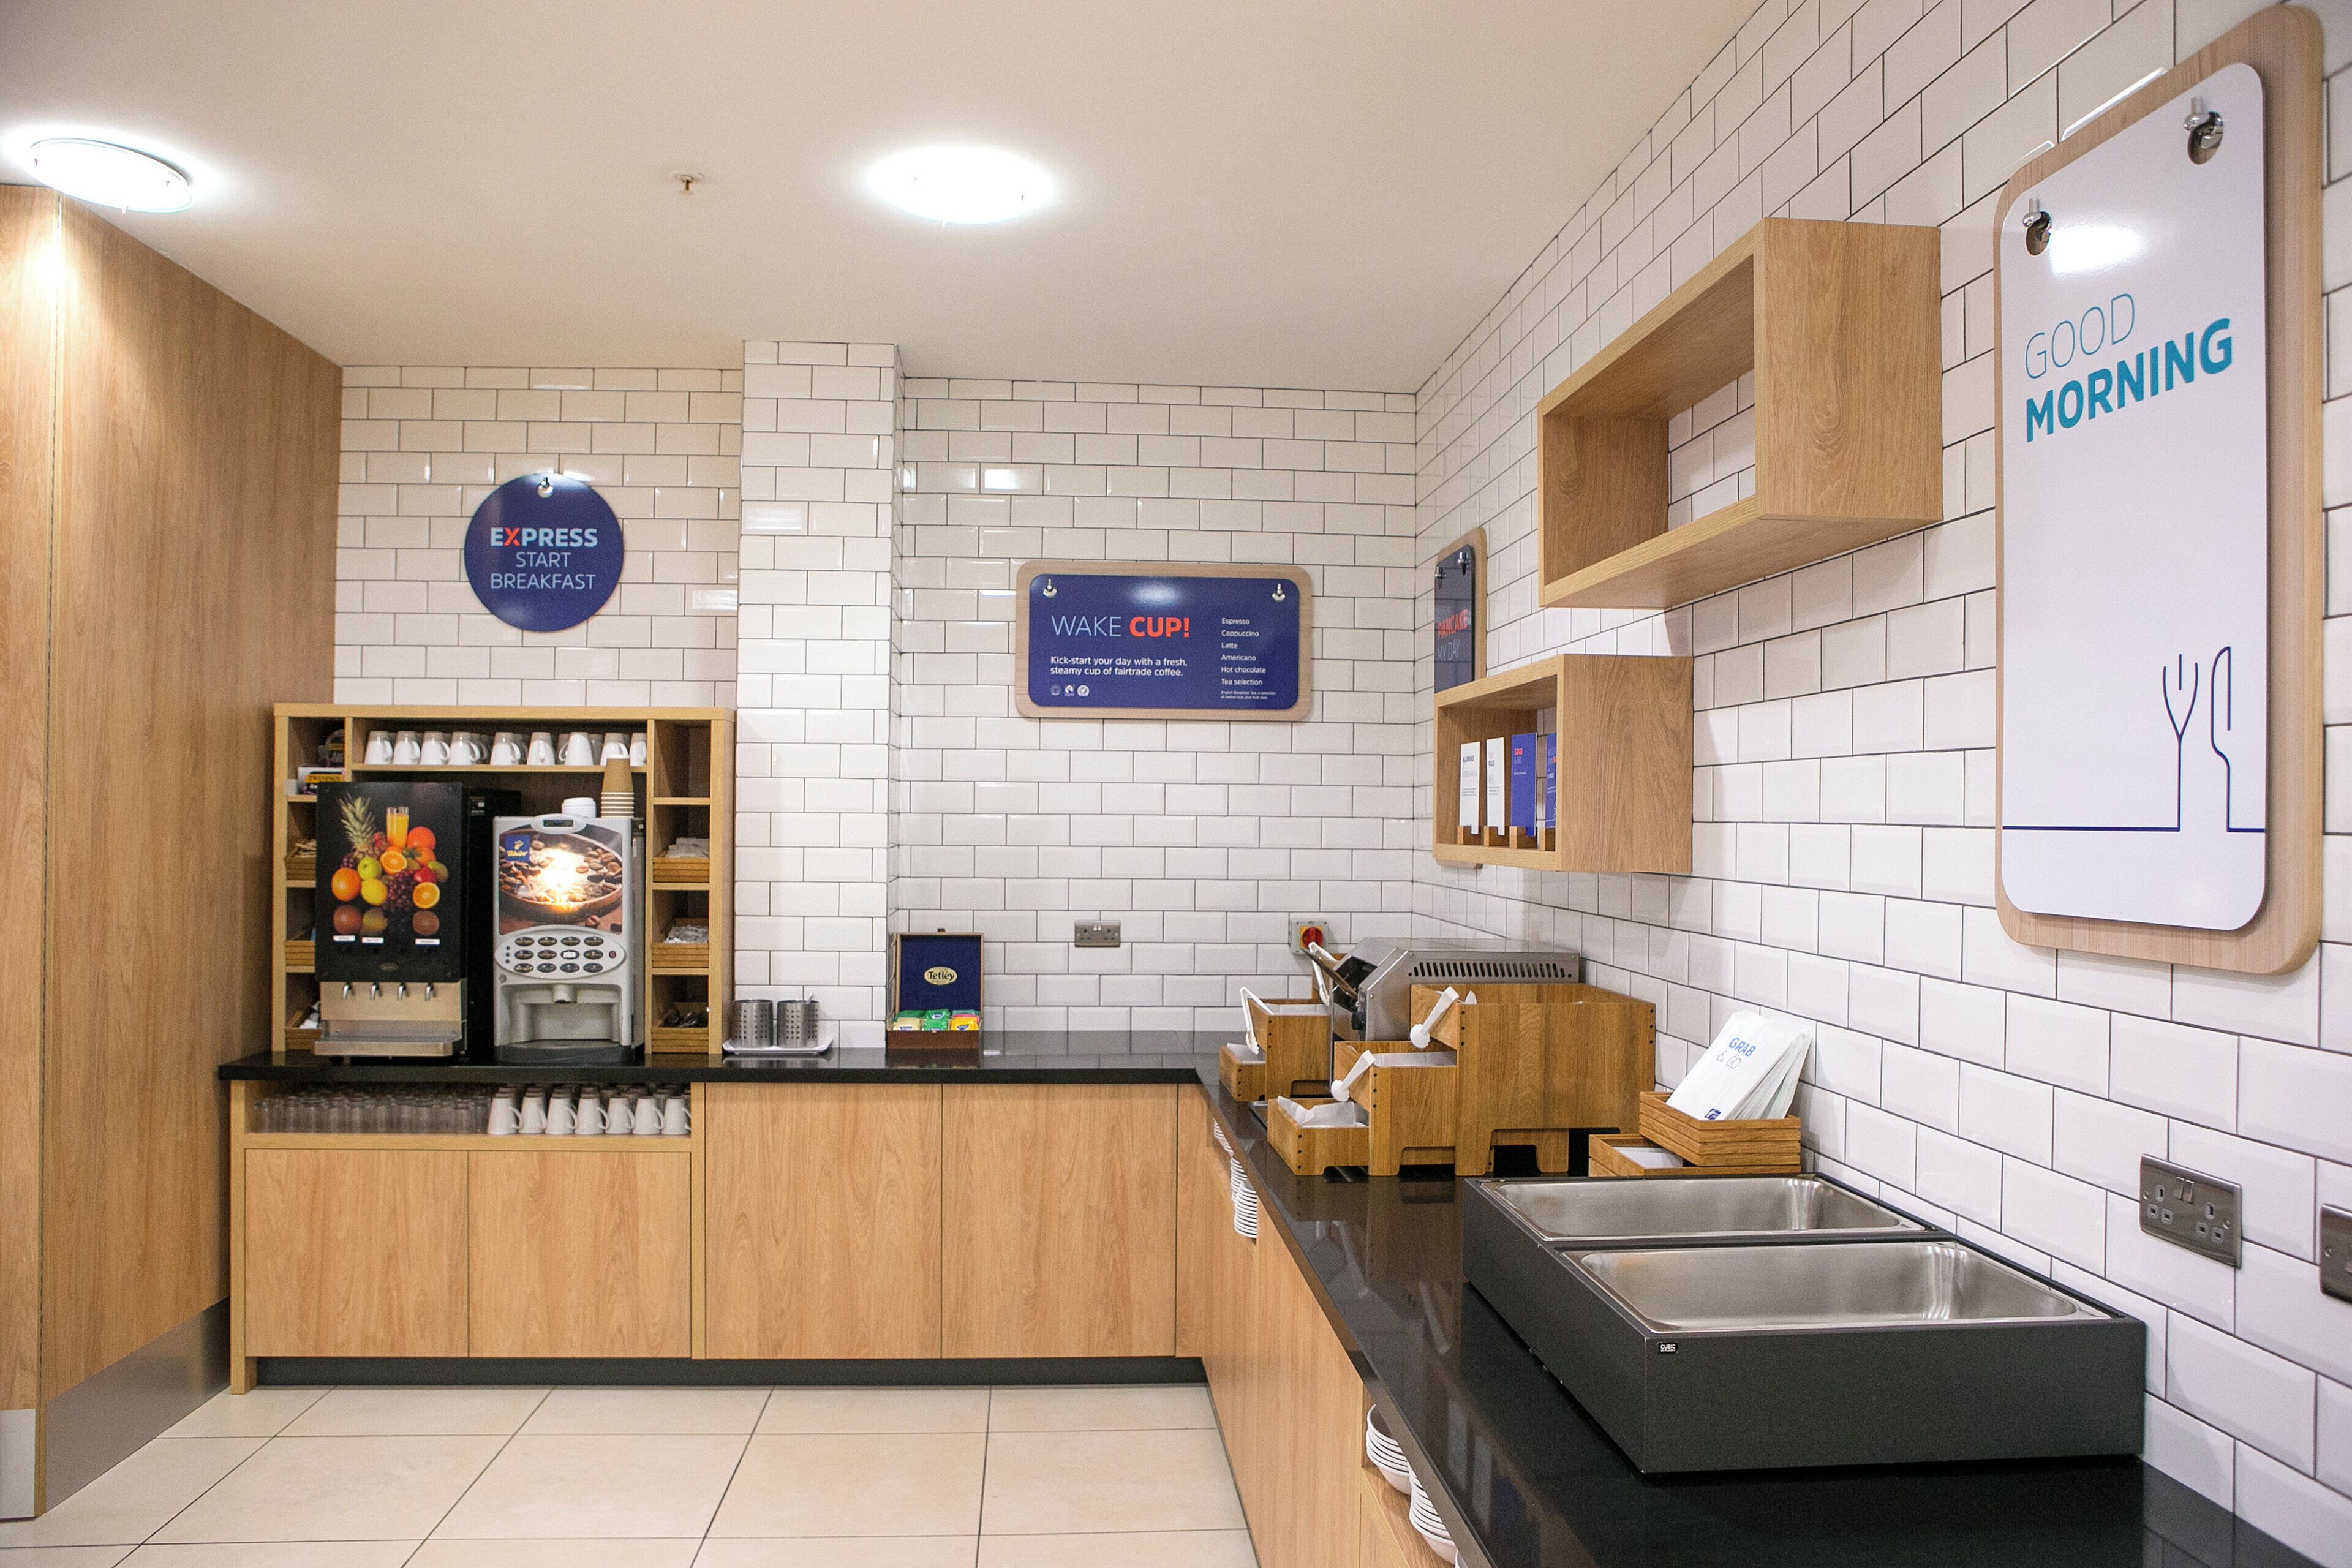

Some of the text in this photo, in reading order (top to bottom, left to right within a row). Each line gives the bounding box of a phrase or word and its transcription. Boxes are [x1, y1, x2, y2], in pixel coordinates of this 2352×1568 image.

[2025, 293, 2135, 379] GOOD
[2026, 318, 2233, 443] MORNING
[491, 527, 598, 548] EXPRESS
[516, 551, 571, 568] START
[491, 573, 596, 589] BREAKFAST
[1051, 615, 1191, 638] WAKE CUP!
[1438, 608, 1468, 639] PANCAKE
[1448, 639, 1461, 661] DAY
[1050, 655, 1093, 665] Kick-start
[1093, 658, 1114, 666] your
[1115, 657, 1131, 666] day
[1134, 657, 1153, 666] with
[1163, 657, 1188, 667] fresh,
[1050, 667, 1083, 676] steamy
[1084, 668, 1101, 677] cup
[1115, 667, 1152, 676] fairtrade
[1154, 668, 1183, 677] coffee.
[928, 971, 955, 980] Tetley
[1728, 1037, 1756, 1057] GRAB
[1717, 1050, 1741, 1069] & GO
